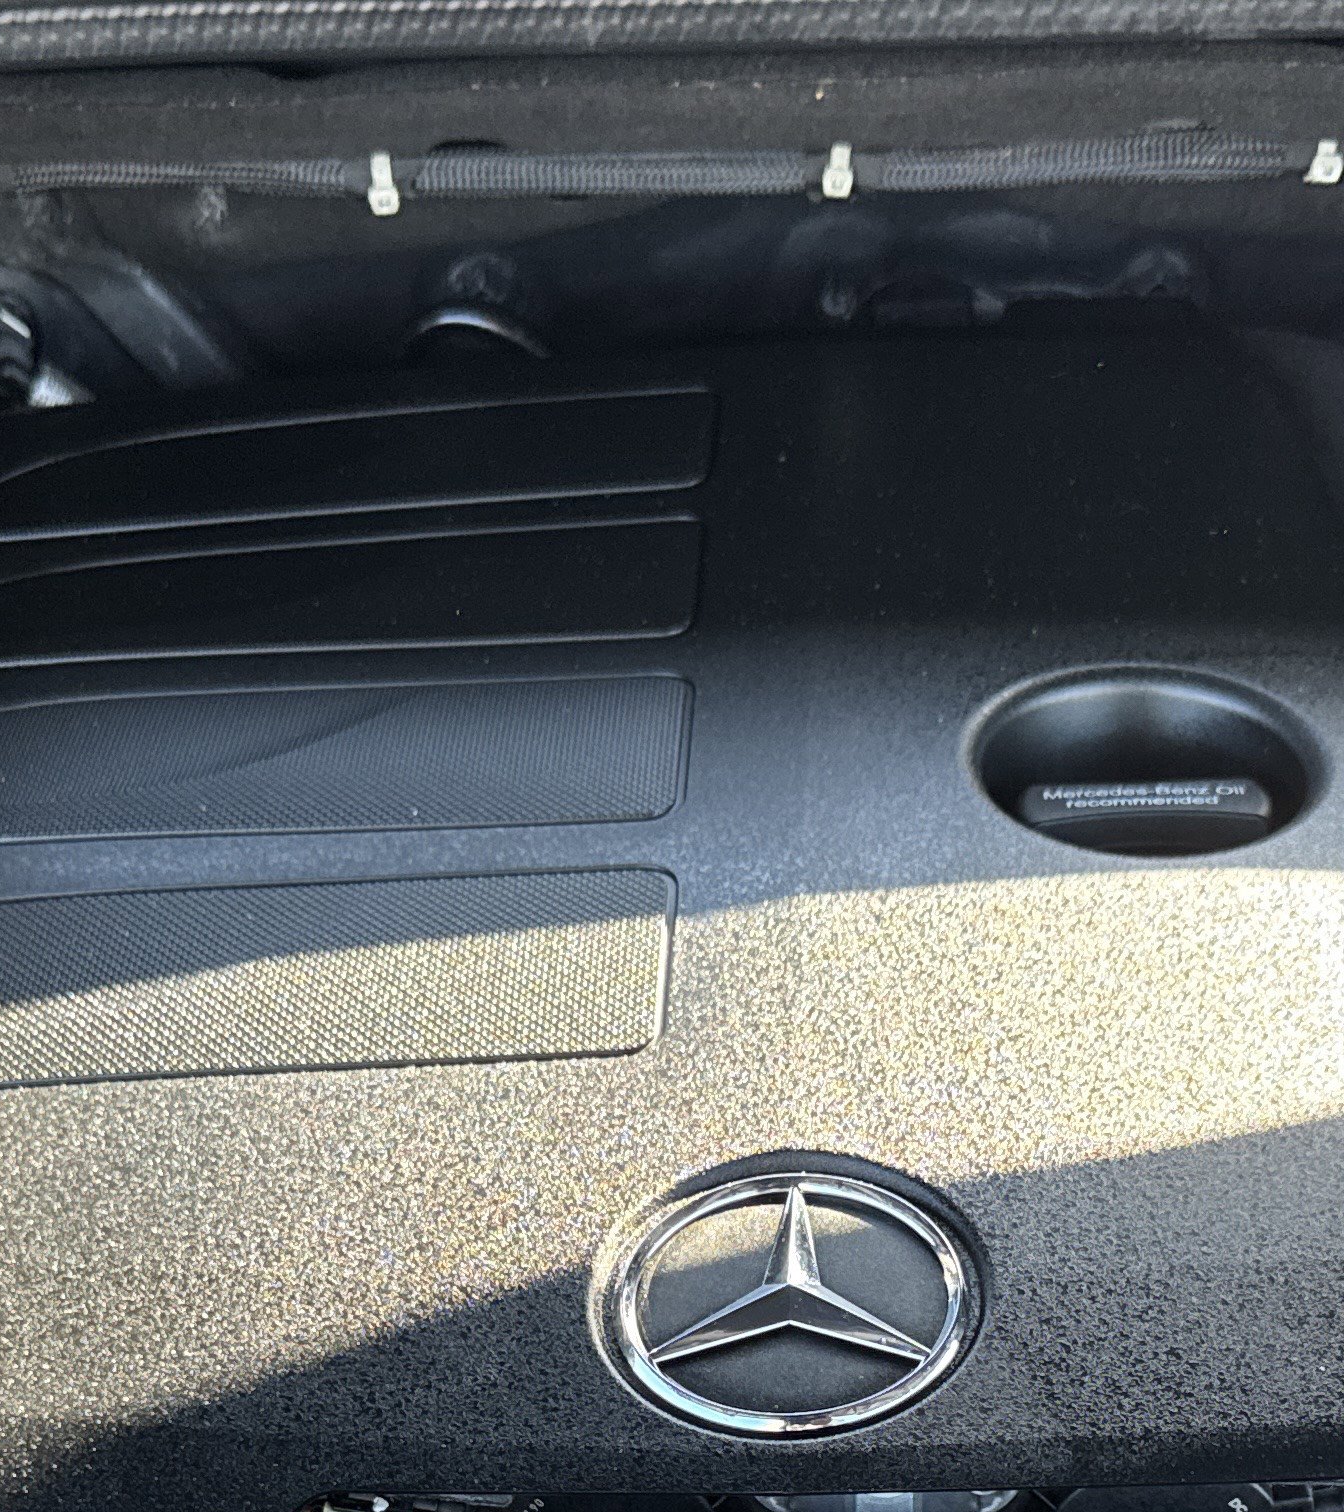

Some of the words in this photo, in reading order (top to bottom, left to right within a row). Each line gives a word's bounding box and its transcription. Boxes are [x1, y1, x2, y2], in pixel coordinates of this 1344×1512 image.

[1042, 784, 1209, 801] Mercedes-Benz
[1215, 784, 1246, 797] Oil
[1066, 795, 1219, 809] recommended
